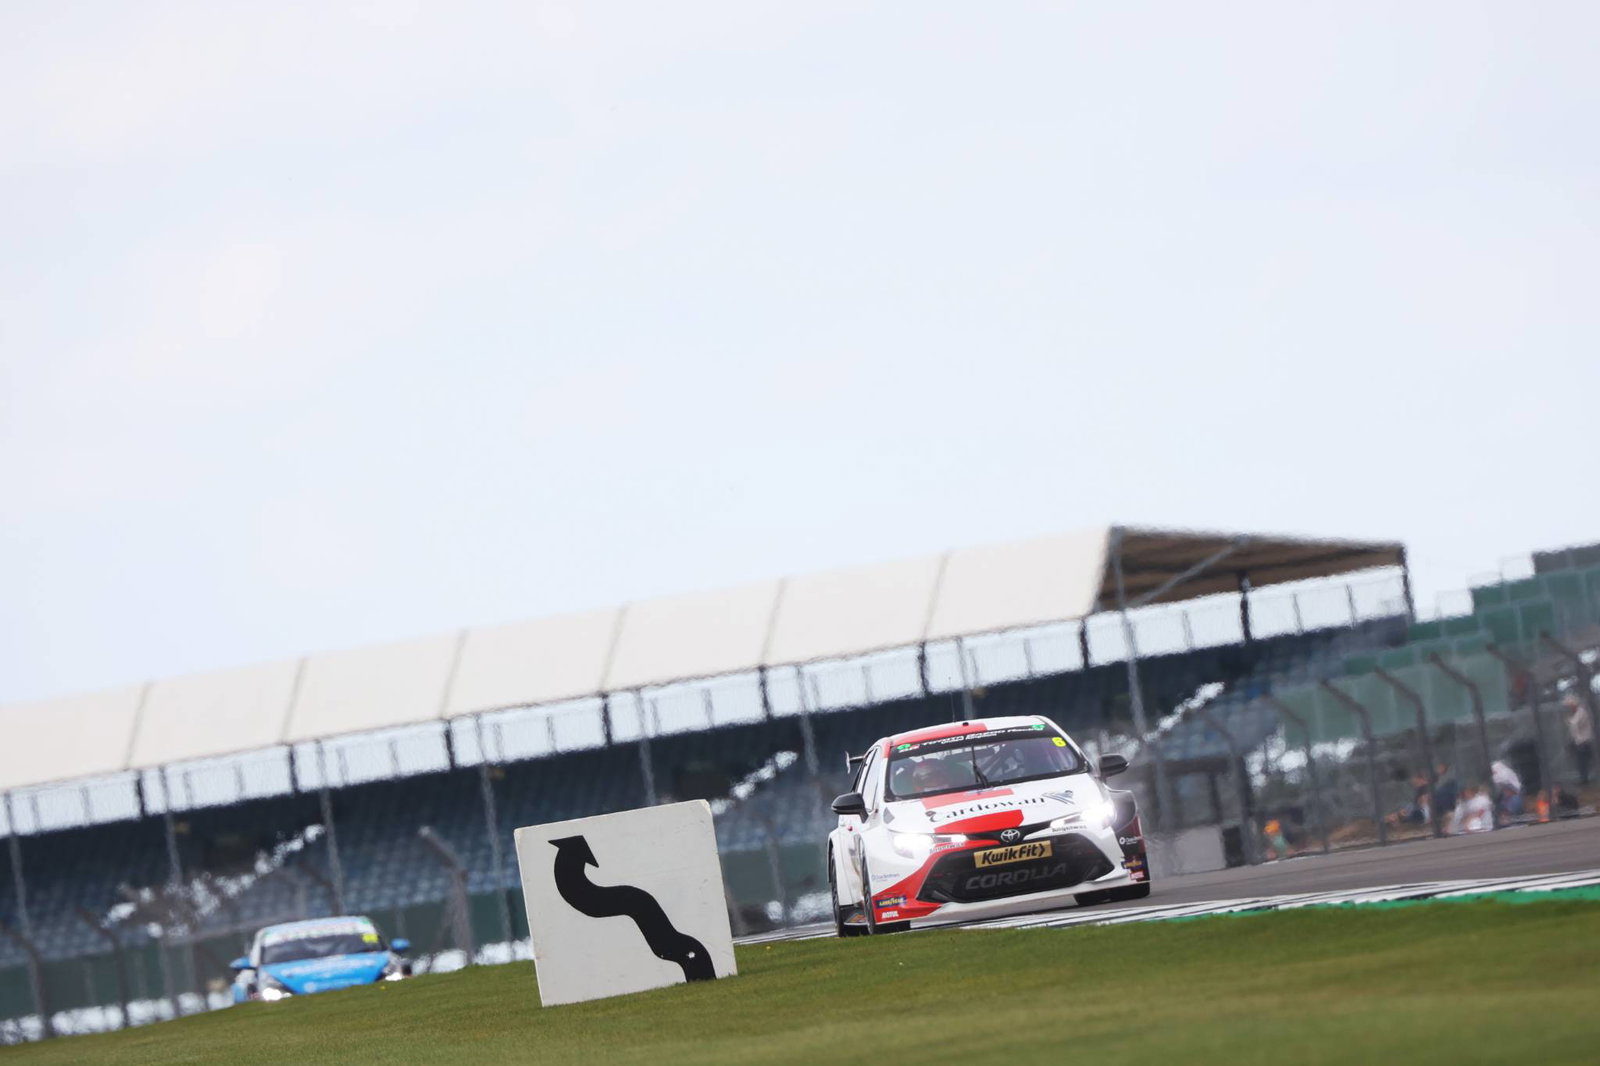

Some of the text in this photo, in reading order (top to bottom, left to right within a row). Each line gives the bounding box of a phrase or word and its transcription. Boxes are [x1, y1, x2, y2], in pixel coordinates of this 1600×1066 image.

[1051, 737, 1067, 748] 6
[926, 797, 1046, 823] Cardowan
[965, 863, 1067, 890] COROLLA
